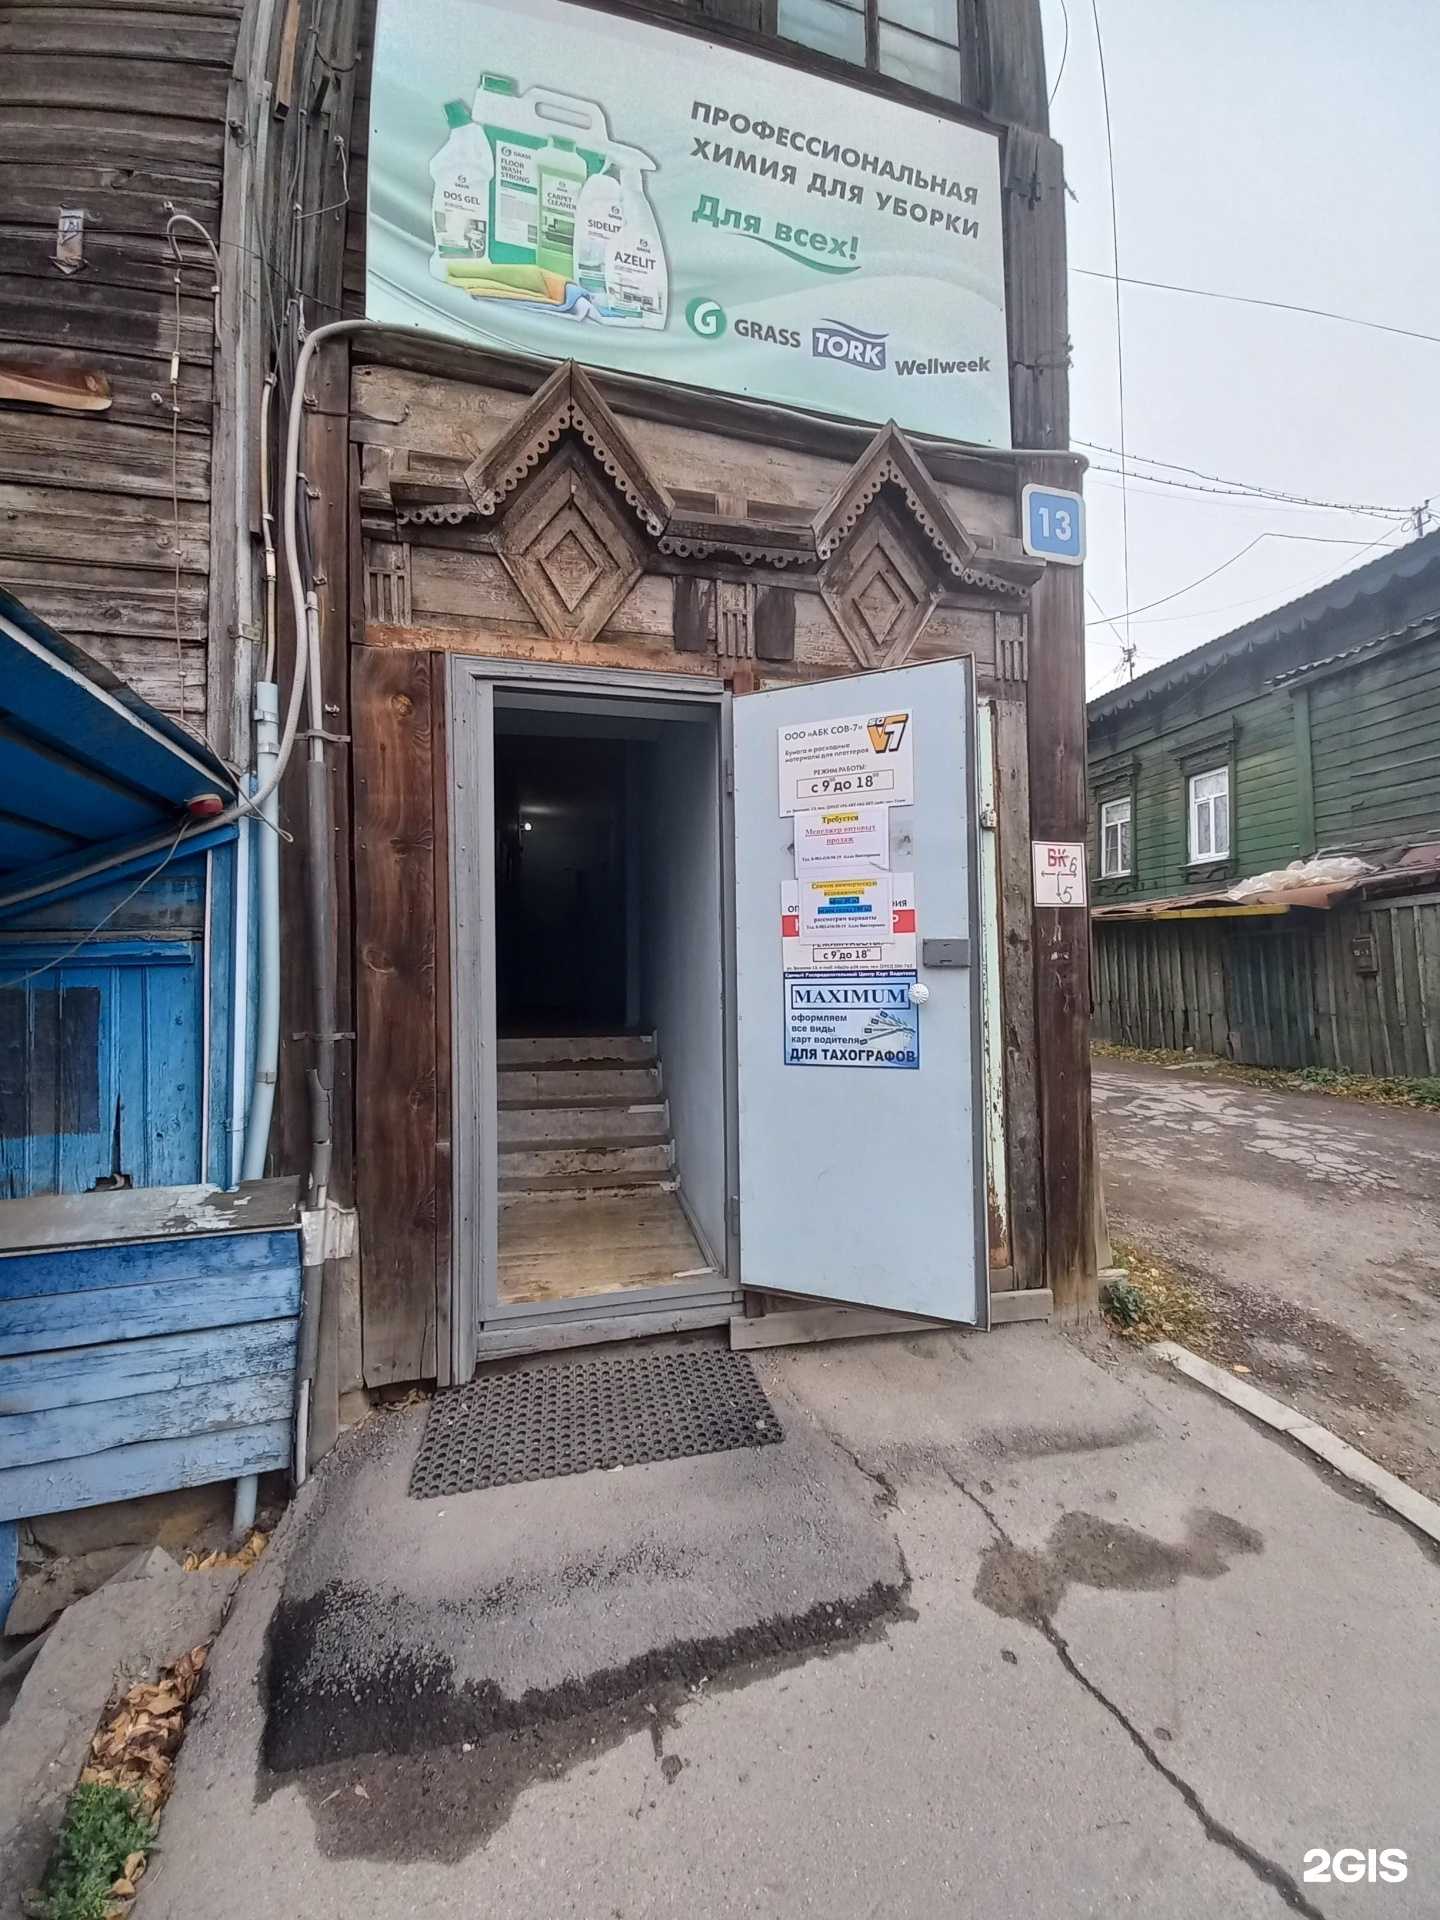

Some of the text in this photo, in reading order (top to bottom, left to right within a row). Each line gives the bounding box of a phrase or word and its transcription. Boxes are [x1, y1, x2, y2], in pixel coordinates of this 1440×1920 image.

[690, 100, 979, 206] ПРОФЕССИОНАЛЬНАЯ
[500, 165, 523, 176] WASH
[500, 172, 531, 185] STRONG
[690, 136, 980, 239] ХИМИЯ ДЛЯ УБОРКИ
[443, 190, 481, 206] DOS GEL
[587, 218, 622, 234] SIDELIT
[691, 194, 861, 261] Для всех!
[614, 250, 657, 271] AZELIT
[734, 318, 801, 349] GRASS
[815, 332, 882, 366] TORK
[894, 356, 991, 377] Wellweek
[1038, 507, 1072, 542] 13
[833, 780, 852, 793] до
[1059, 886, 1074, 905] 5
[839, 952, 853, 960] до
[794, 989, 905, 1004] MAXIMUM
[791, 1037, 860, 1045] карт водителя
[790, 1048, 917, 1063] ДЛЯ ТАХОГРАФОВ
